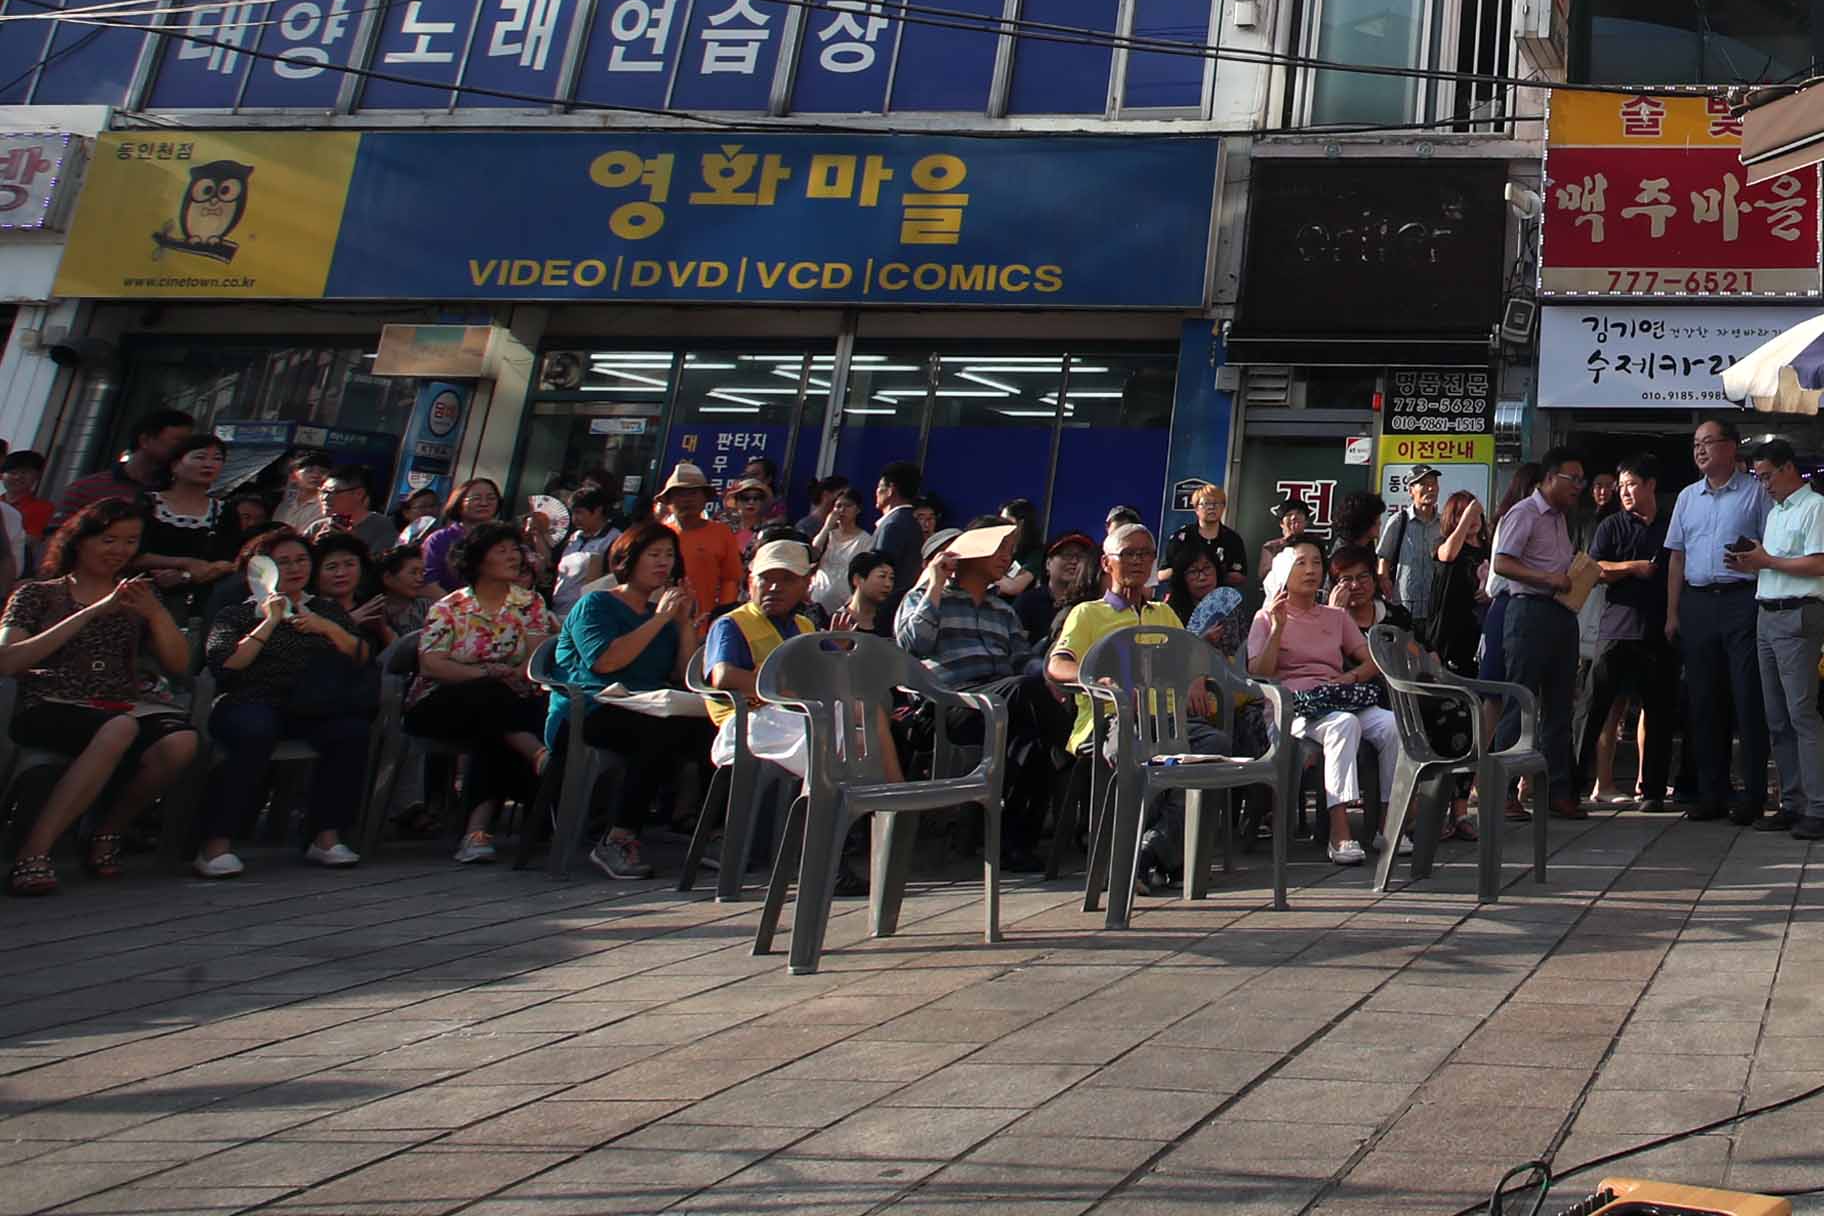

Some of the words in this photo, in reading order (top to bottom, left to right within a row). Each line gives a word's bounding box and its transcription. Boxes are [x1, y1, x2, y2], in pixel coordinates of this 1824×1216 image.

[117, 142, 195, 162] 동인천점
[589, 143, 969, 246] 영화마을
[1552, 171, 1808, 244] 맥주마을
[123, 274, 256, 290] www.cinetown.co.kr
[469, 258, 606, 289] VIDEO
[631, 260, 730, 290] DVD
[756, 261, 854, 291] VCD
[878, 263, 1064, 294] COMICS
[1607, 270, 1755, 294] 777-6521
[1582, 314, 1666, 344] 김기연
[1393, 398, 1487, 414] 773-5629
[716, 433, 768, 452] 판타지
[1397, 439, 1475, 460] 이전안내
